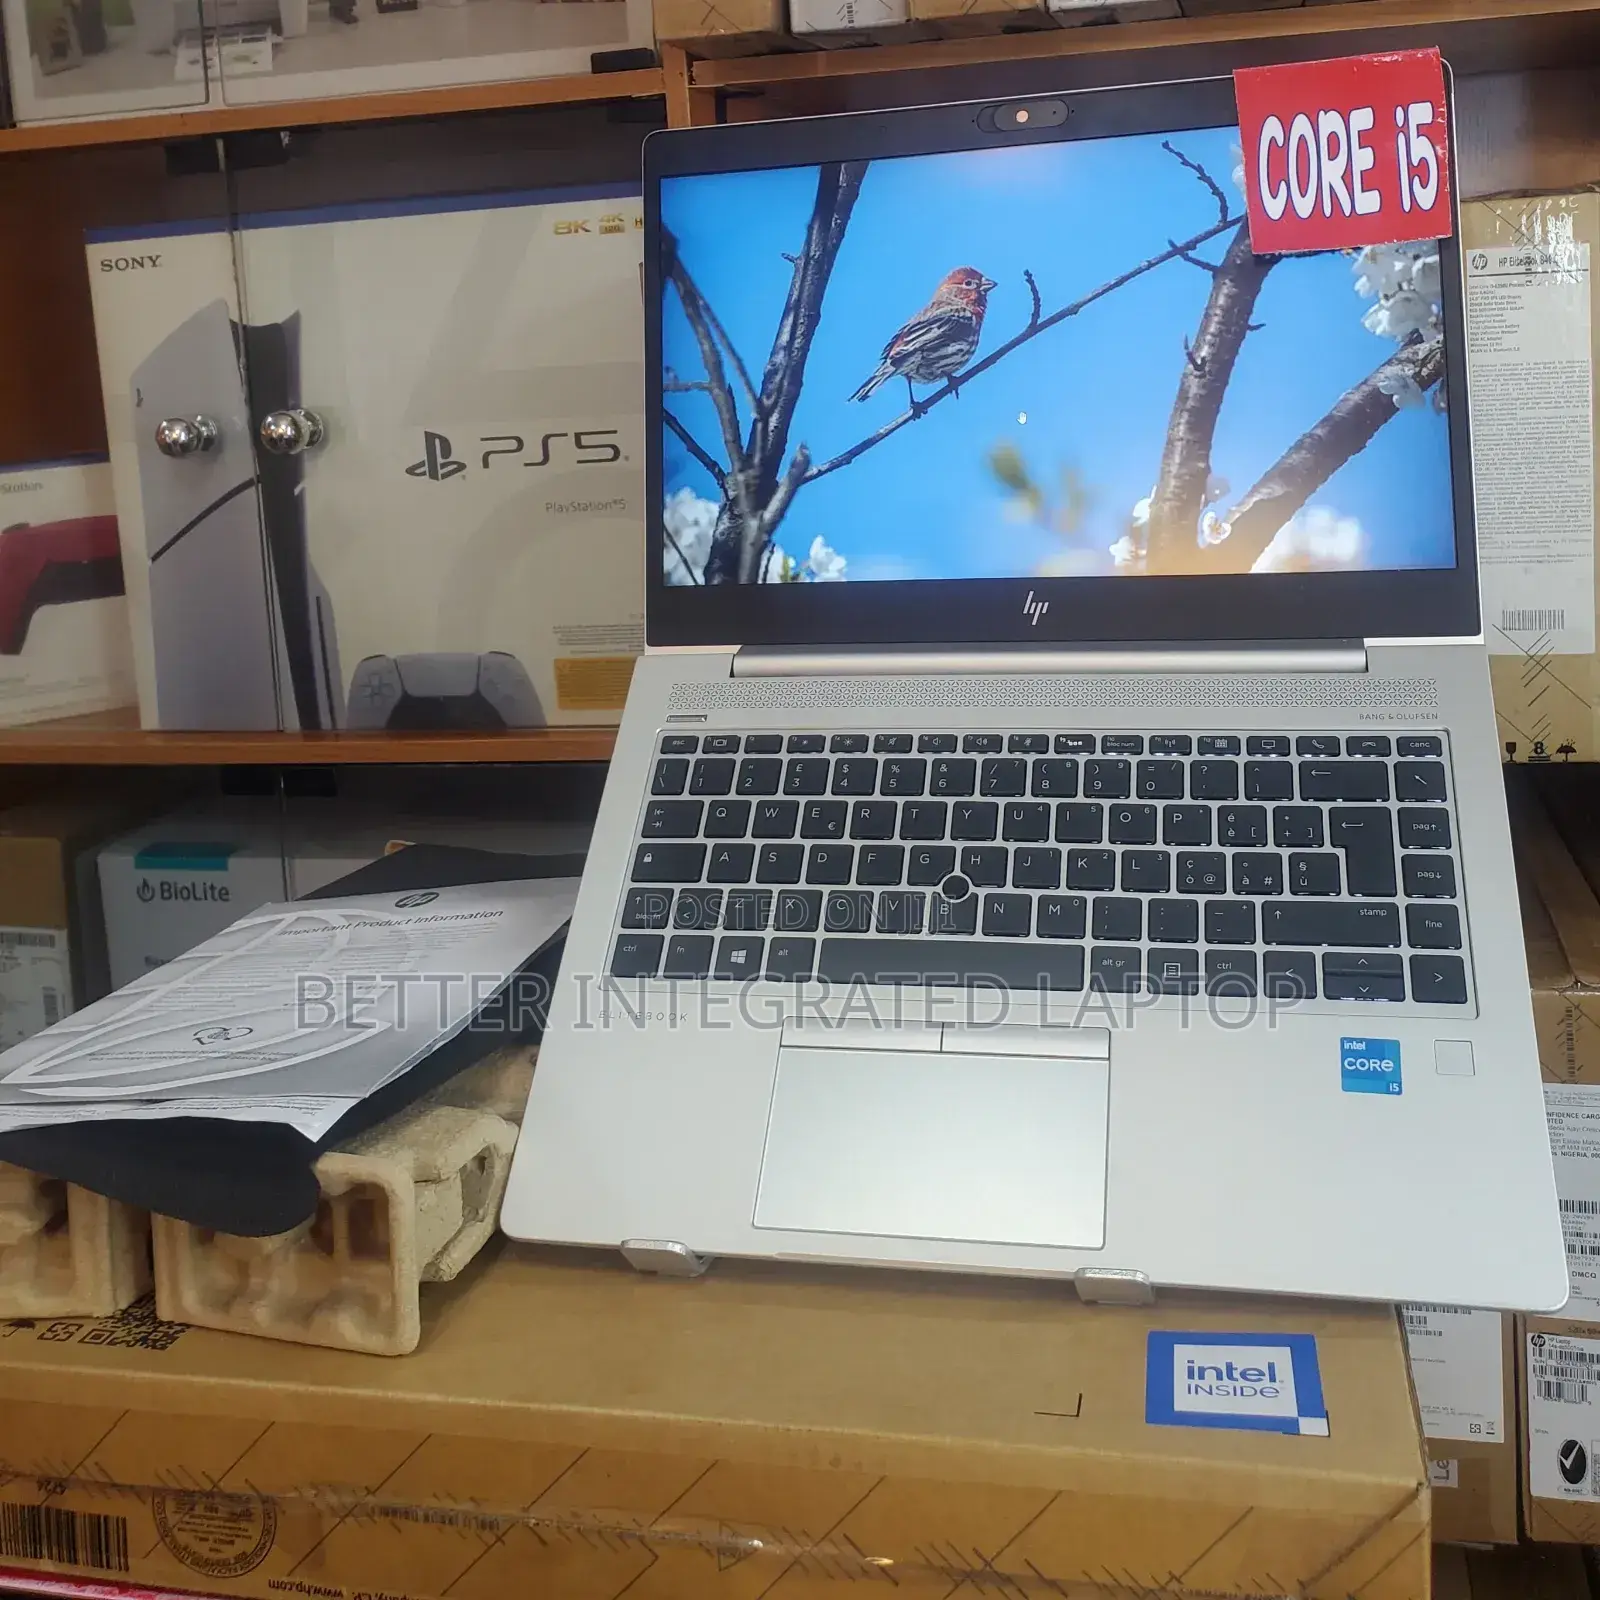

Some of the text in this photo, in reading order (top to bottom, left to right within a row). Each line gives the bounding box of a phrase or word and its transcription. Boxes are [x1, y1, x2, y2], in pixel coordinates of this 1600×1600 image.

[1258, 101, 1439, 221] CORE i5
[600, 213, 624, 223] 4K
[554, 219, 591, 235] 8K
[100, 255, 162, 272] SONY
[1499, 257, 1508, 268] HP
[480, 430, 621, 469] PS5
[1023, 591, 1049, 626] hp
[1533, 741, 1544, 755] 8
[795, 764, 804, 772] £
[842, 763, 850, 773] $
[891, 765, 900, 773] %
[939, 764, 948, 773] &
[745, 778, 753, 787] 2
[792, 778, 800, 787] 3
[840, 778, 848, 787] 4
[889, 779, 897, 788] 5
[938, 779, 946, 788] 6
[990, 779, 997, 788] 7
[1041, 780, 1050, 789] 8
[1093, 780, 1102, 790] 9
[716, 807, 727, 818] Q
[765, 808, 779, 818] W
[811, 808, 821, 818] E
[861, 808, 870, 819] R
[911, 808, 920, 819] T
[962, 809, 972, 819] Y
[1013, 810, 1024, 820] U
[1120, 812, 1132, 823] O
[1173, 813, 1183, 824] P
[828, 821, 836, 831] €
[1413, 823, 1430, 831] pag
[719, 851, 729, 862] A
[768, 852, 777, 862] S
[817, 853, 828, 863] D
[867, 853, 876, 864] F
[919, 853, 930, 864] G
[970, 854, 981, 865] H
[1102, 852, 1108, 860] 2
[1157, 853, 1163, 861] 3
[1023, 856, 1031, 867] J
[1078, 857, 1088, 868] K
[1132, 859, 1141, 870] L
[1203, 873, 1216, 885] @
[1417, 871, 1434, 879] pag
[1263, 876, 1273, 886] #
[160, 881, 230, 902] BioLite
[735, 898, 745, 909] Z
[785, 899, 796, 909] X
[836, 899, 847, 910] C
[888, 900, 899, 911] V
[993, 903, 1004, 914] N
[940, 904, 950, 915] B
[1048, 905, 1061, 916] M
[1359, 908, 1388, 917] stamp
[354, 917, 414, 930] Product
[414, 909, 504, 925] Information
[1425, 920, 1443, 928] fine
[623, 944, 637, 952] ctrl
[676, 946, 685, 954] fn
[1102, 958, 1125, 968] alt gr
[1217, 961, 1232, 970] ctrl
[1344, 1040, 1366, 1050] intel
[1389, 1082, 1399, 1092] i5
[1186, 1360, 1277, 1383] intel
[268, 1577, 344, 1599] www.hp.com
